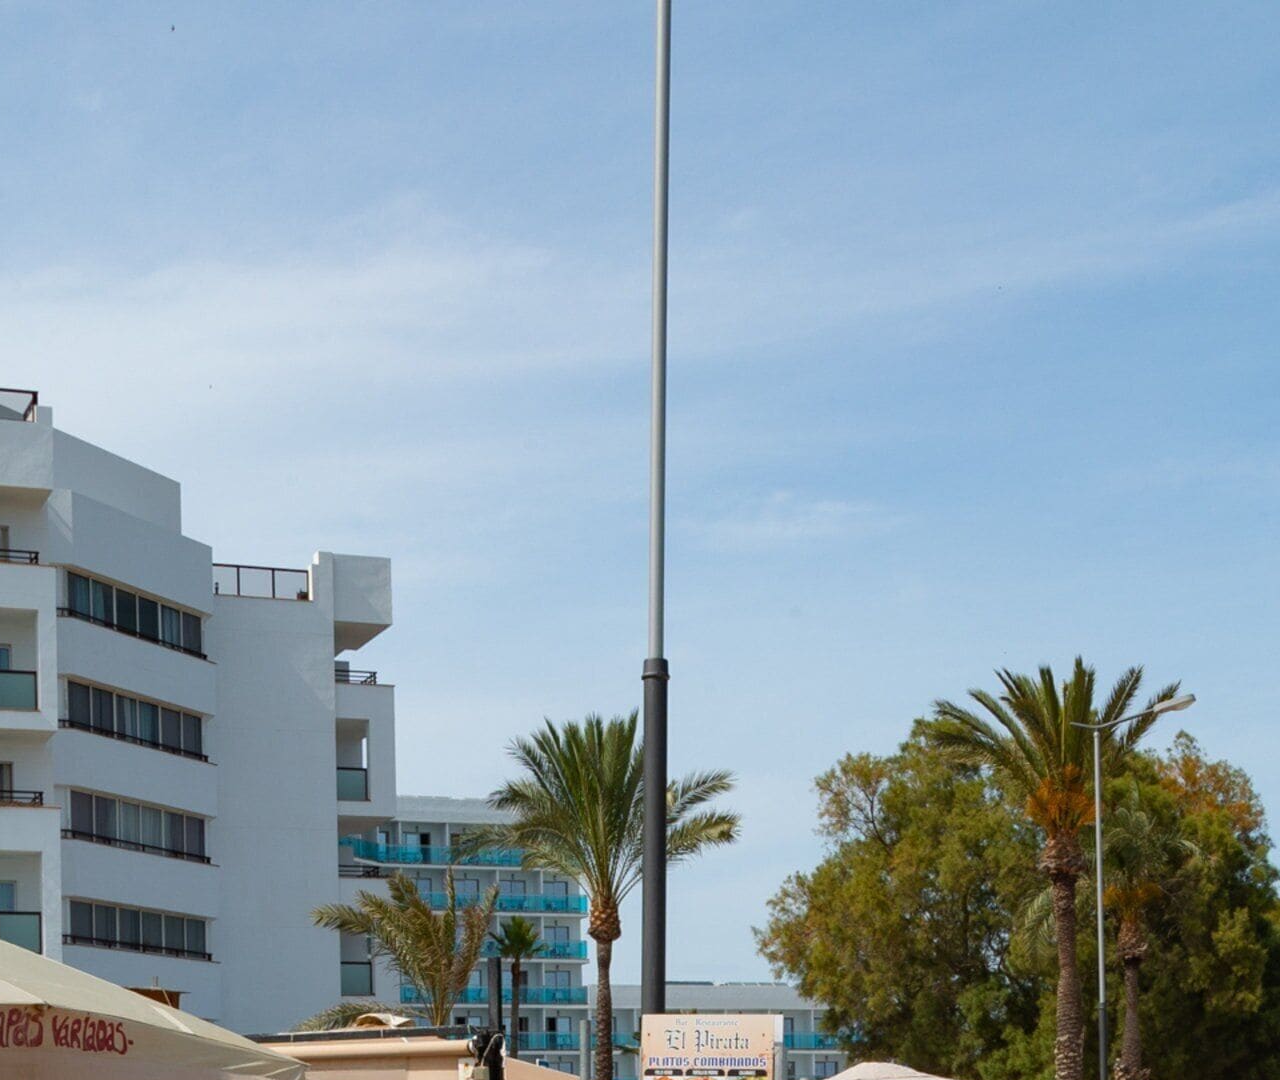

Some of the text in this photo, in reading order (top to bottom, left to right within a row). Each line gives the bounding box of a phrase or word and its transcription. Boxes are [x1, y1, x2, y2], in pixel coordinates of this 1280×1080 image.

[664, 1029, 750, 1052] El Pirata
[649, 1056, 767, 1067] PLATOS COMBINADOS
